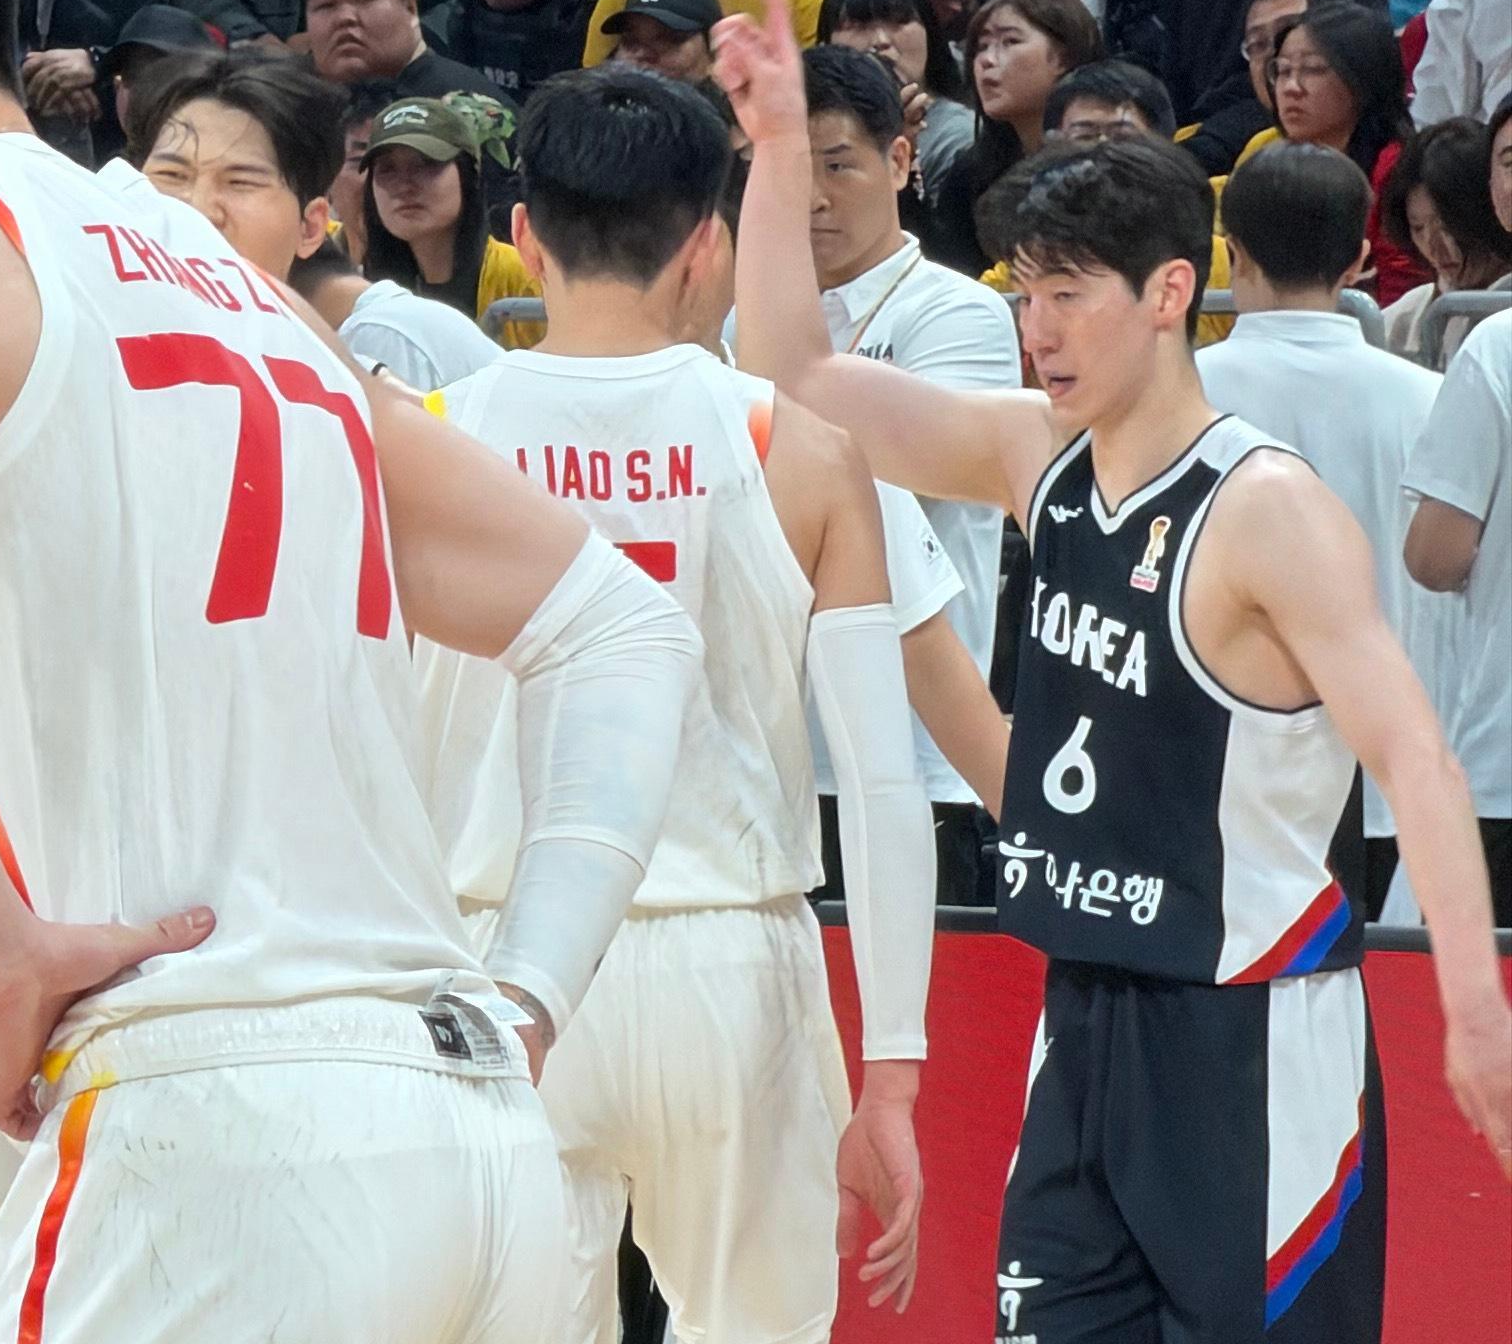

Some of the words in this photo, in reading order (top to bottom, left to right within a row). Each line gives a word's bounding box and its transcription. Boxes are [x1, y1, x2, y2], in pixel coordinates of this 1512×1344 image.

[115, 331, 392, 641] 77
[626, 444, 707, 503] S.N.
[1042, 715, 1097, 814] 6
